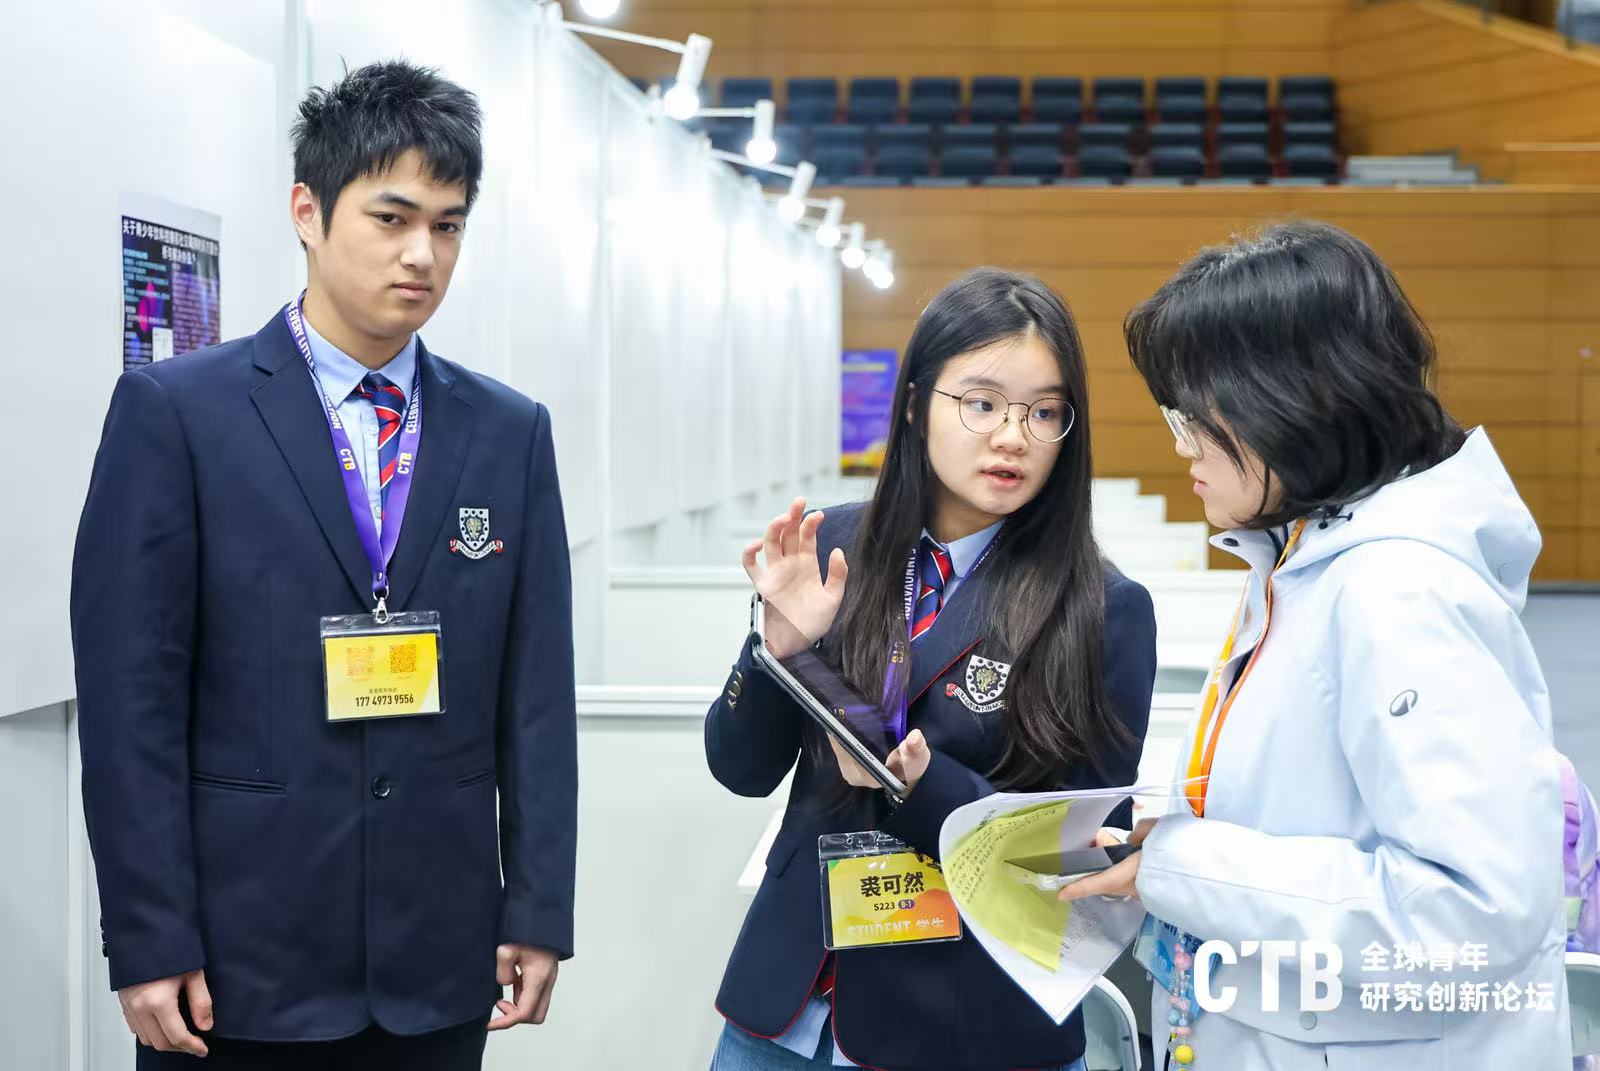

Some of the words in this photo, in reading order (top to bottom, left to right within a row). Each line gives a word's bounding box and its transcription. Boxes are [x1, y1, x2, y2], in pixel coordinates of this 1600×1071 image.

[288, 308, 305, 338] EVERY
[340, 448, 356, 471] CTB
[397, 453, 413, 475] CTB
[355, 696, 370, 707] 177
[372, 694, 393, 706] 4973
[394, 693, 414, 705] 9556
[860, 871, 926, 898] 裘可然
[873, 901, 896, 911] S223
